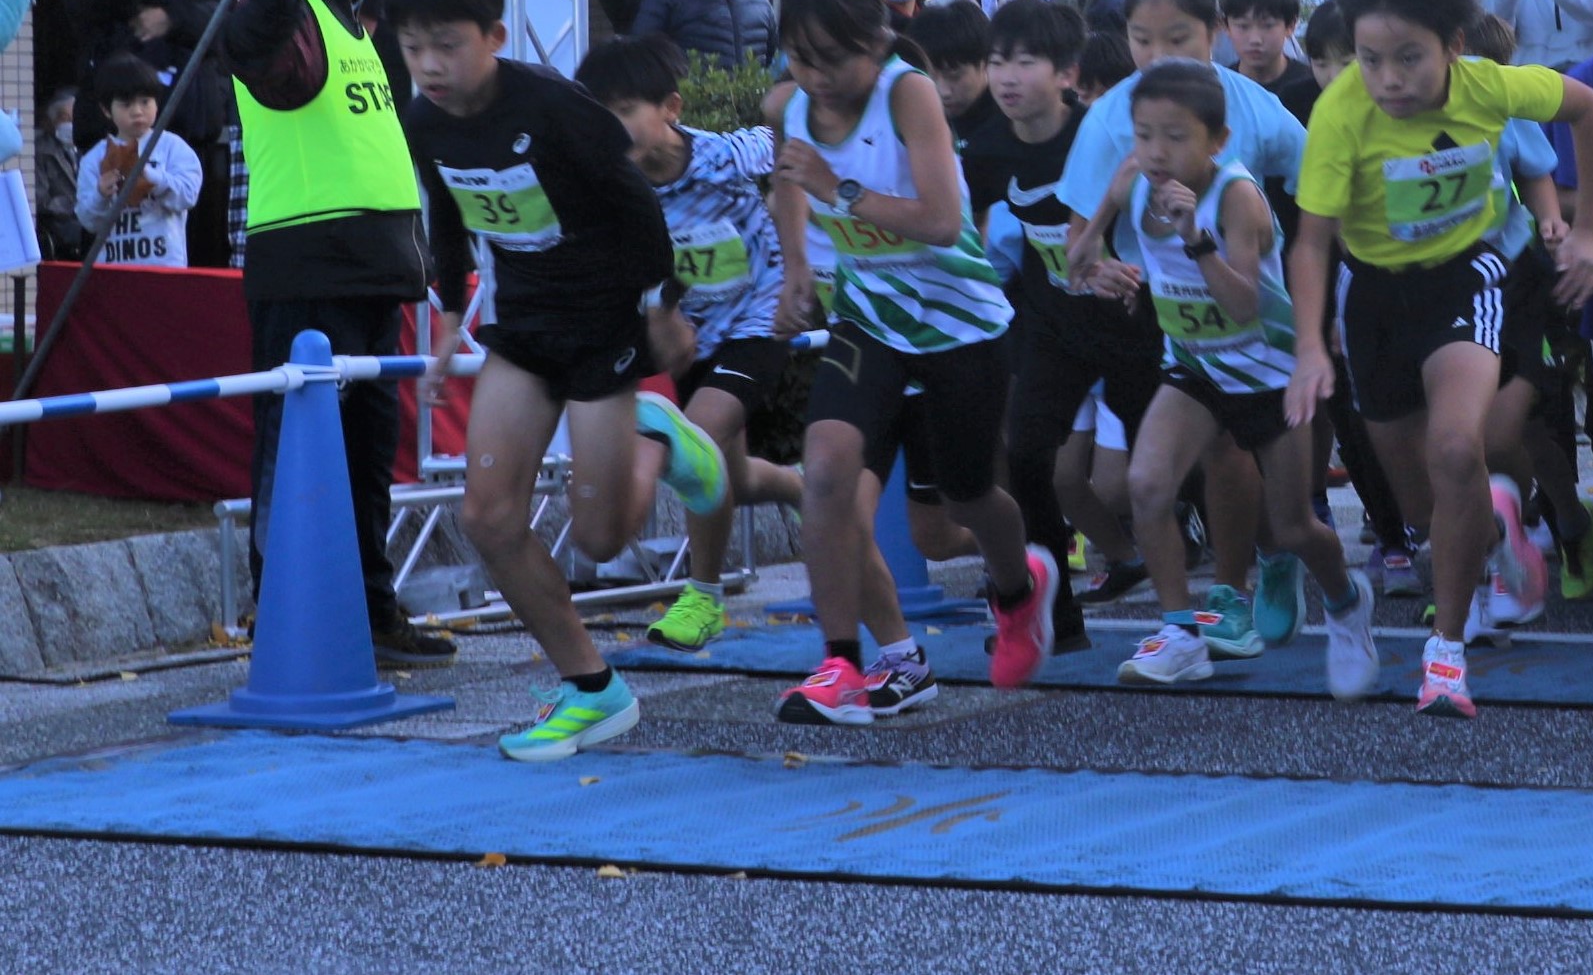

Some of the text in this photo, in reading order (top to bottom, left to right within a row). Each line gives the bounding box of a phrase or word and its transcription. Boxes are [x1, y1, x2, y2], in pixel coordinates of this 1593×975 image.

[474, 193, 521, 225] 39
[1419, 173, 1469, 214] 27
[105, 235, 167, 263] DINOS
[677, 248, 716, 278] 47
[1178, 303, 1226, 334] 54
